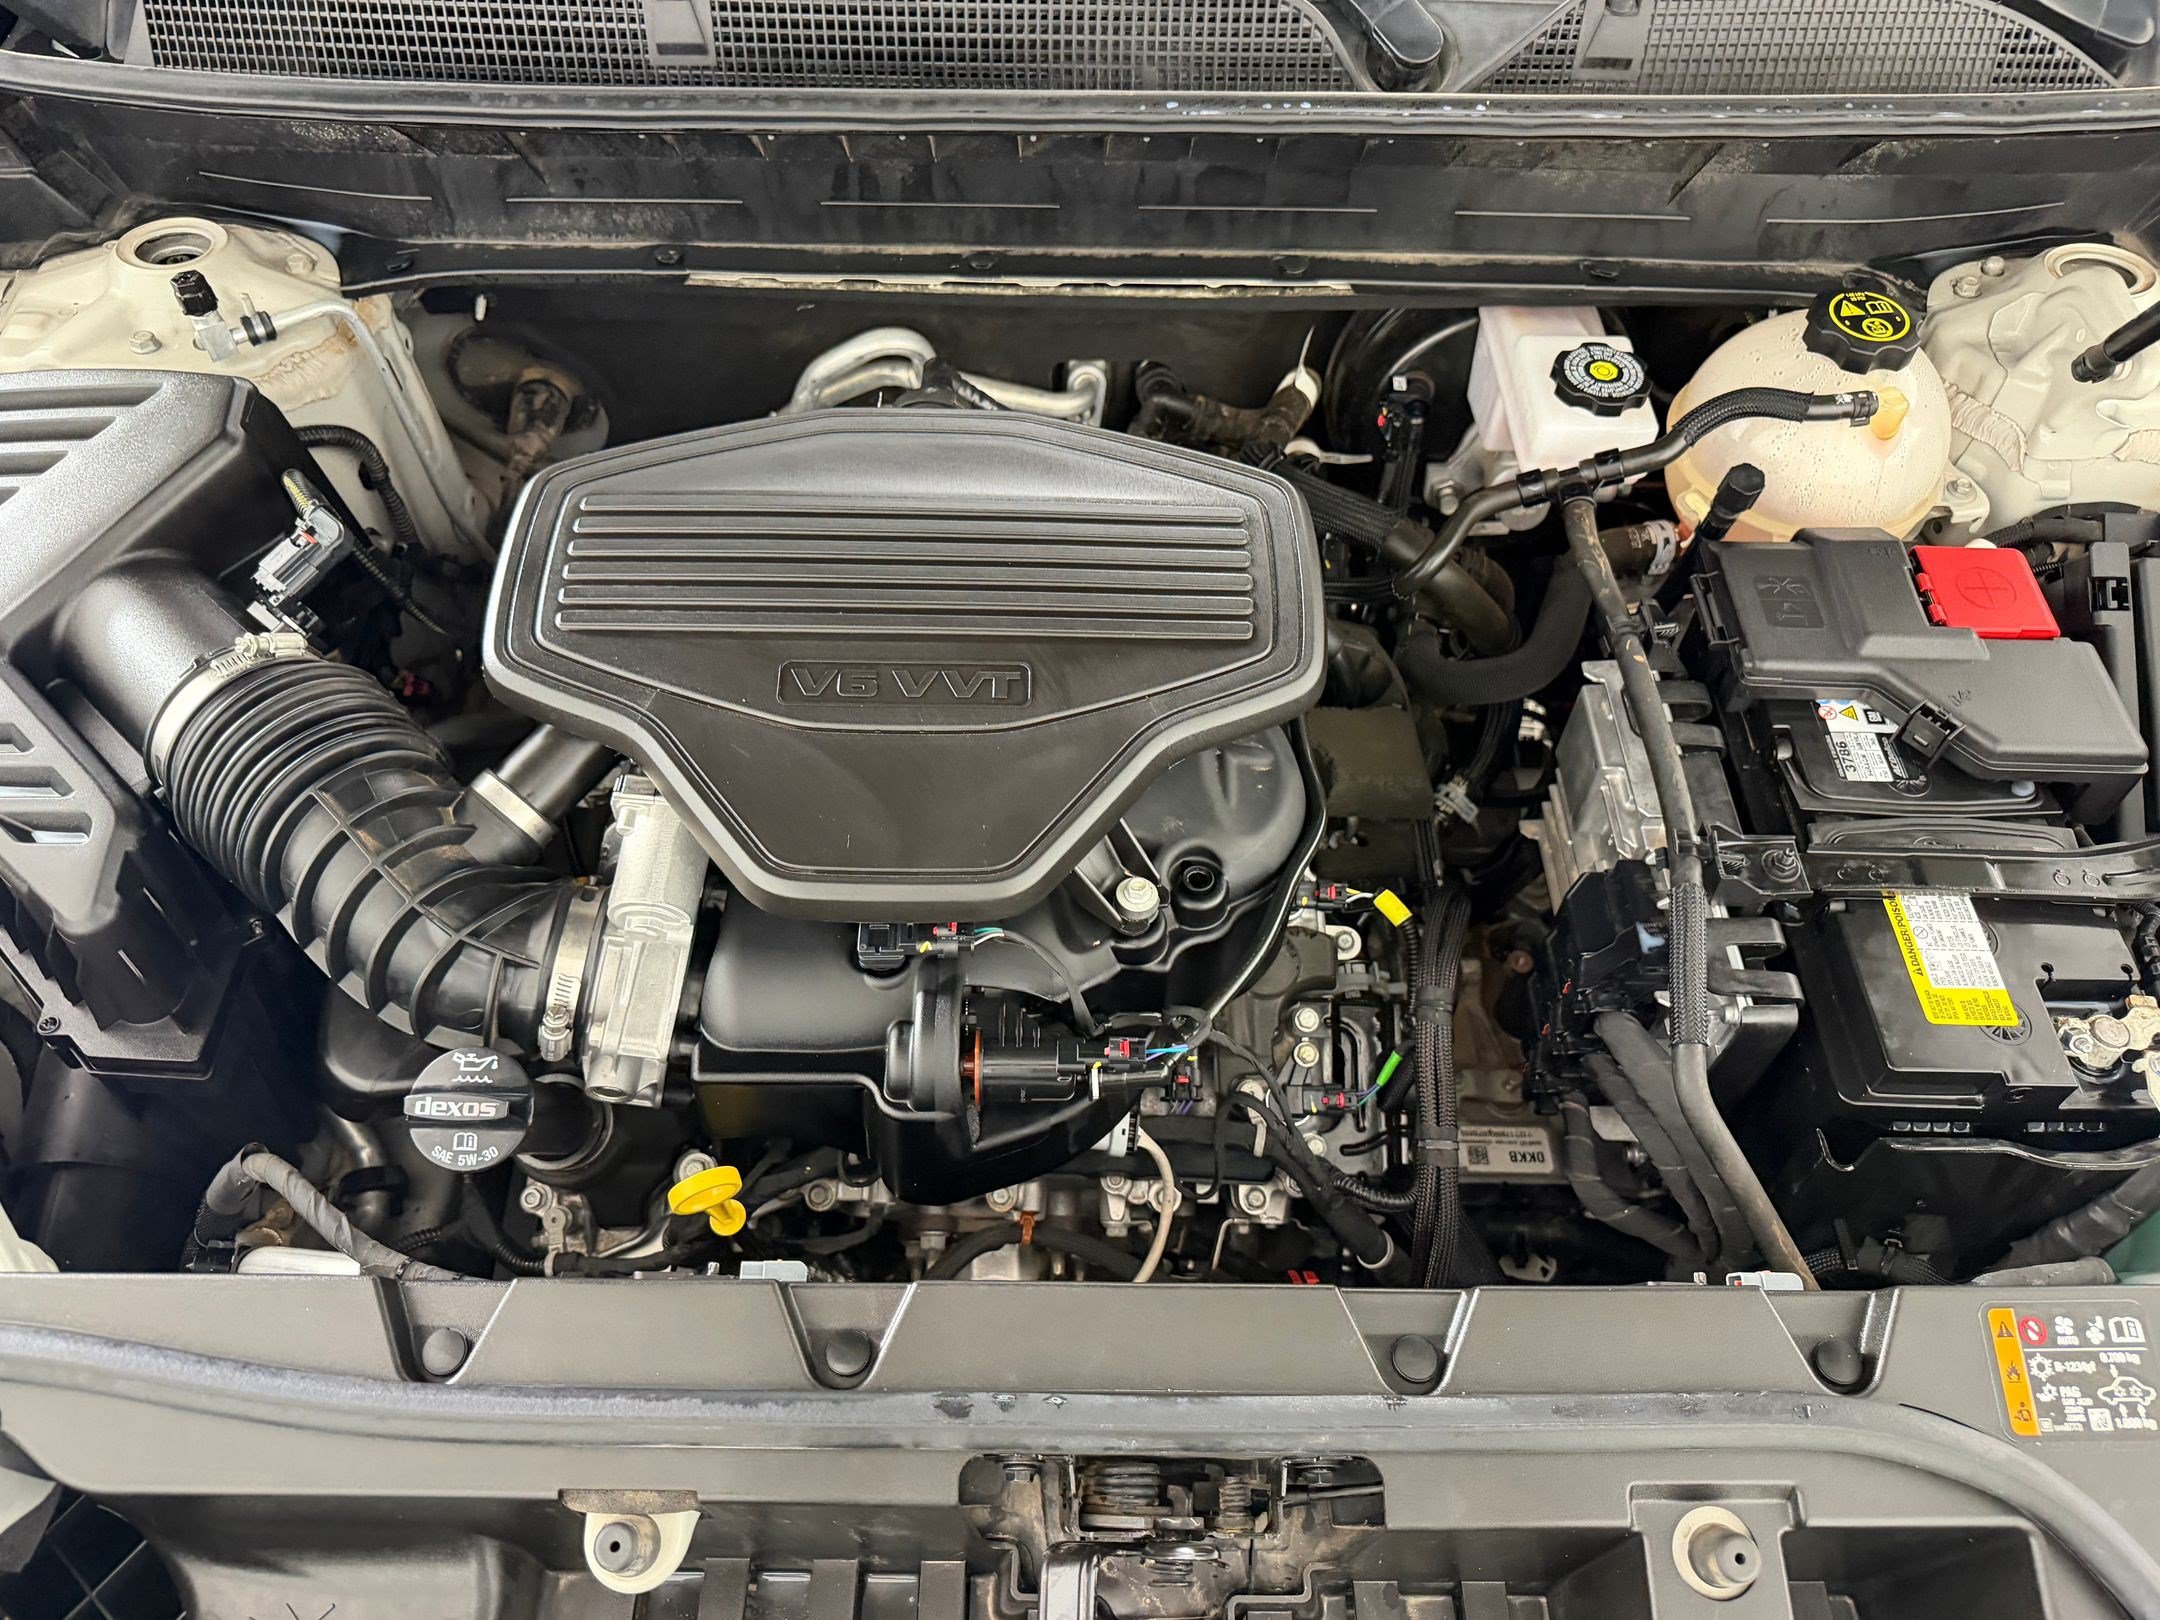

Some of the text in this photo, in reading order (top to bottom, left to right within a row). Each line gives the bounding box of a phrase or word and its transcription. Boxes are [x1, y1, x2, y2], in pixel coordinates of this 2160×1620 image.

[791, 669, 1021, 698] V6 VVT
[1836, 741, 1856, 772] 3786
[414, 1097, 497, 1117] dexos
[431, 1145, 499, 1166] SAE 5W-30
[2057, 1335, 2079, 1345] AUTO
